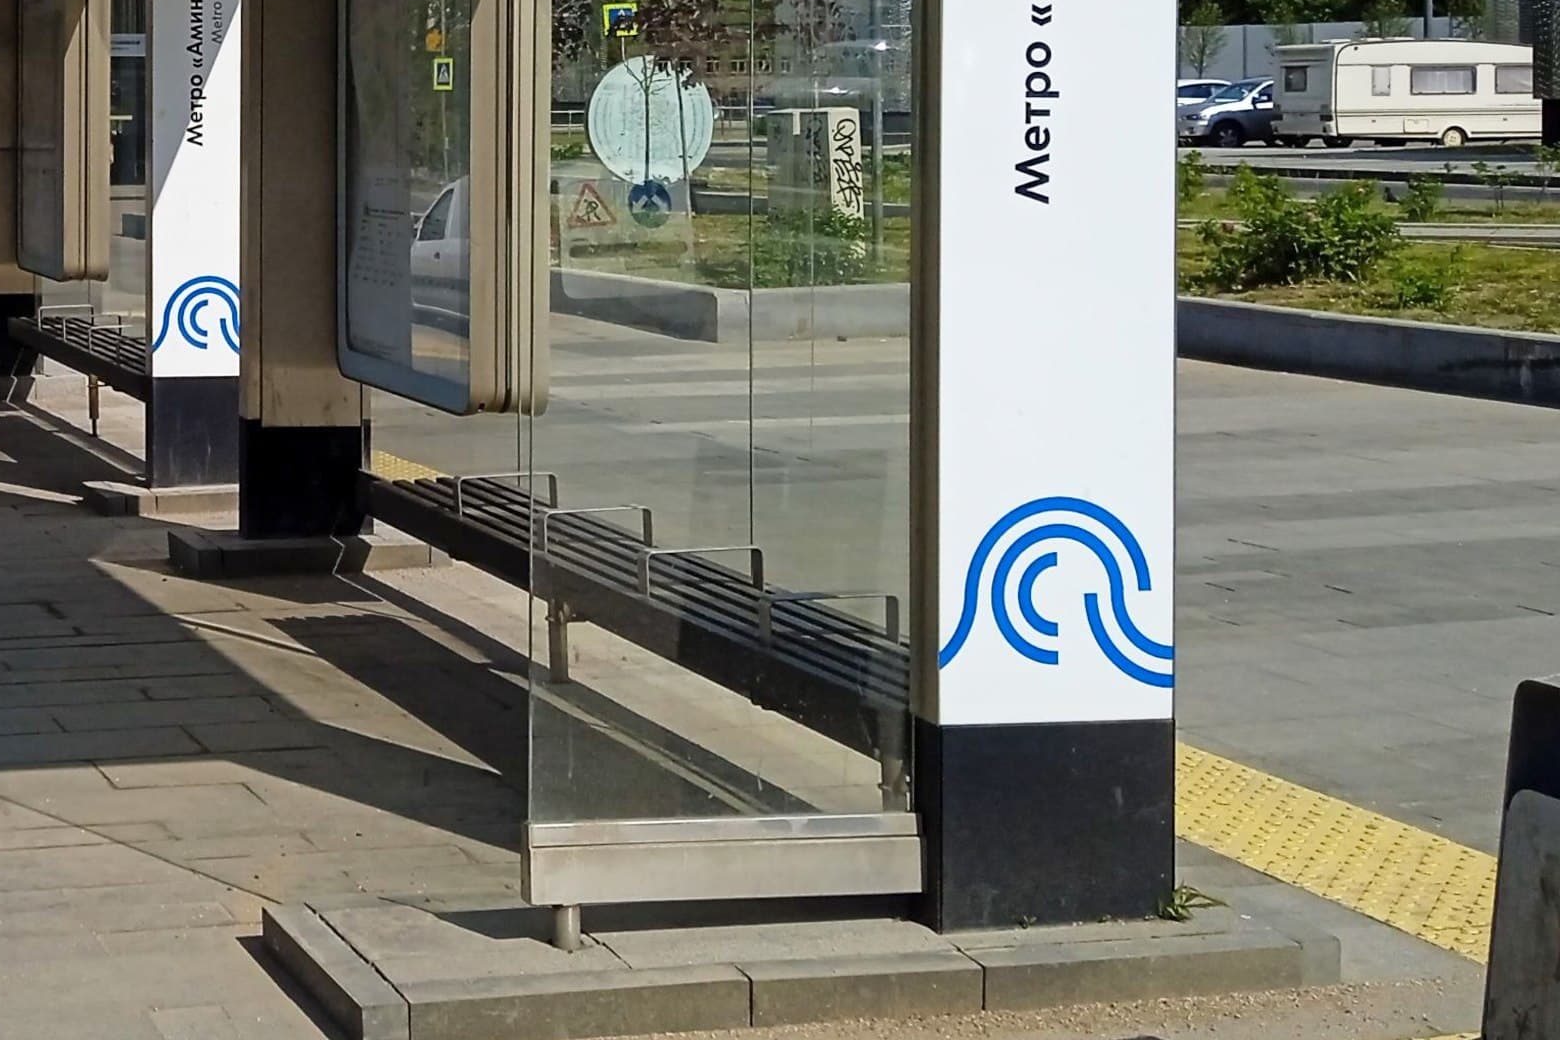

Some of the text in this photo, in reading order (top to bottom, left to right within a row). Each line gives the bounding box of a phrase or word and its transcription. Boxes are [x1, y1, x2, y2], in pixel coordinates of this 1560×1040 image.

[211, 1, 223, 44] Metro
[186, 73, 206, 146] Метро
[1014, 40, 1059, 204] Метро
